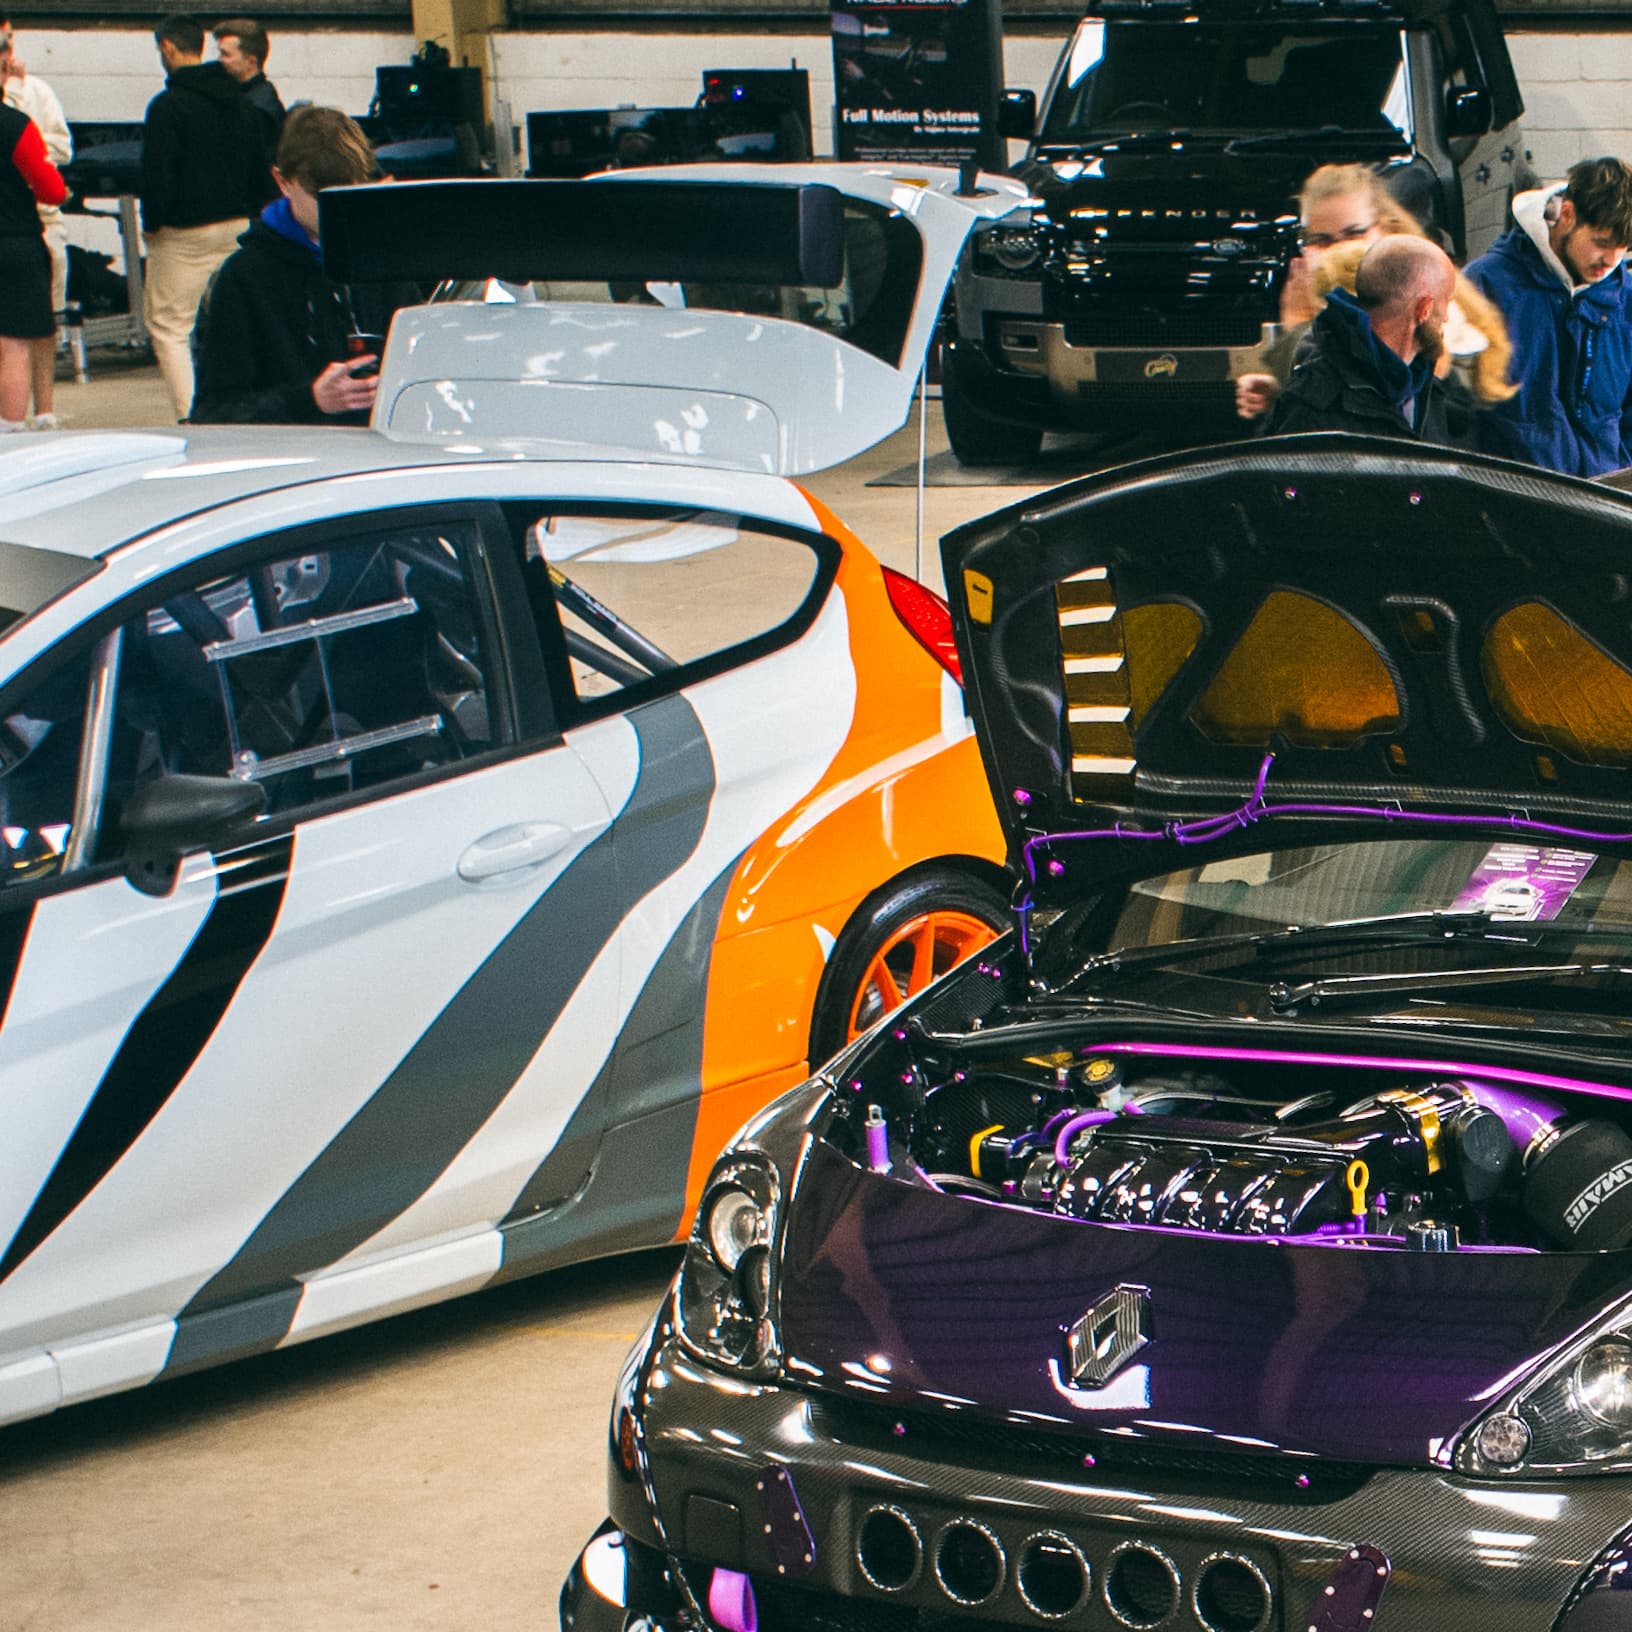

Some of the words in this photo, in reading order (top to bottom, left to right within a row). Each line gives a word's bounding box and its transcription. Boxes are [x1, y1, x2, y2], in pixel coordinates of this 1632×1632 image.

[842, 108, 869, 123] Full
[871, 107, 920, 123] Motion
[922, 108, 981, 126] Systems
[1069, 209, 1257, 219] FENDER
